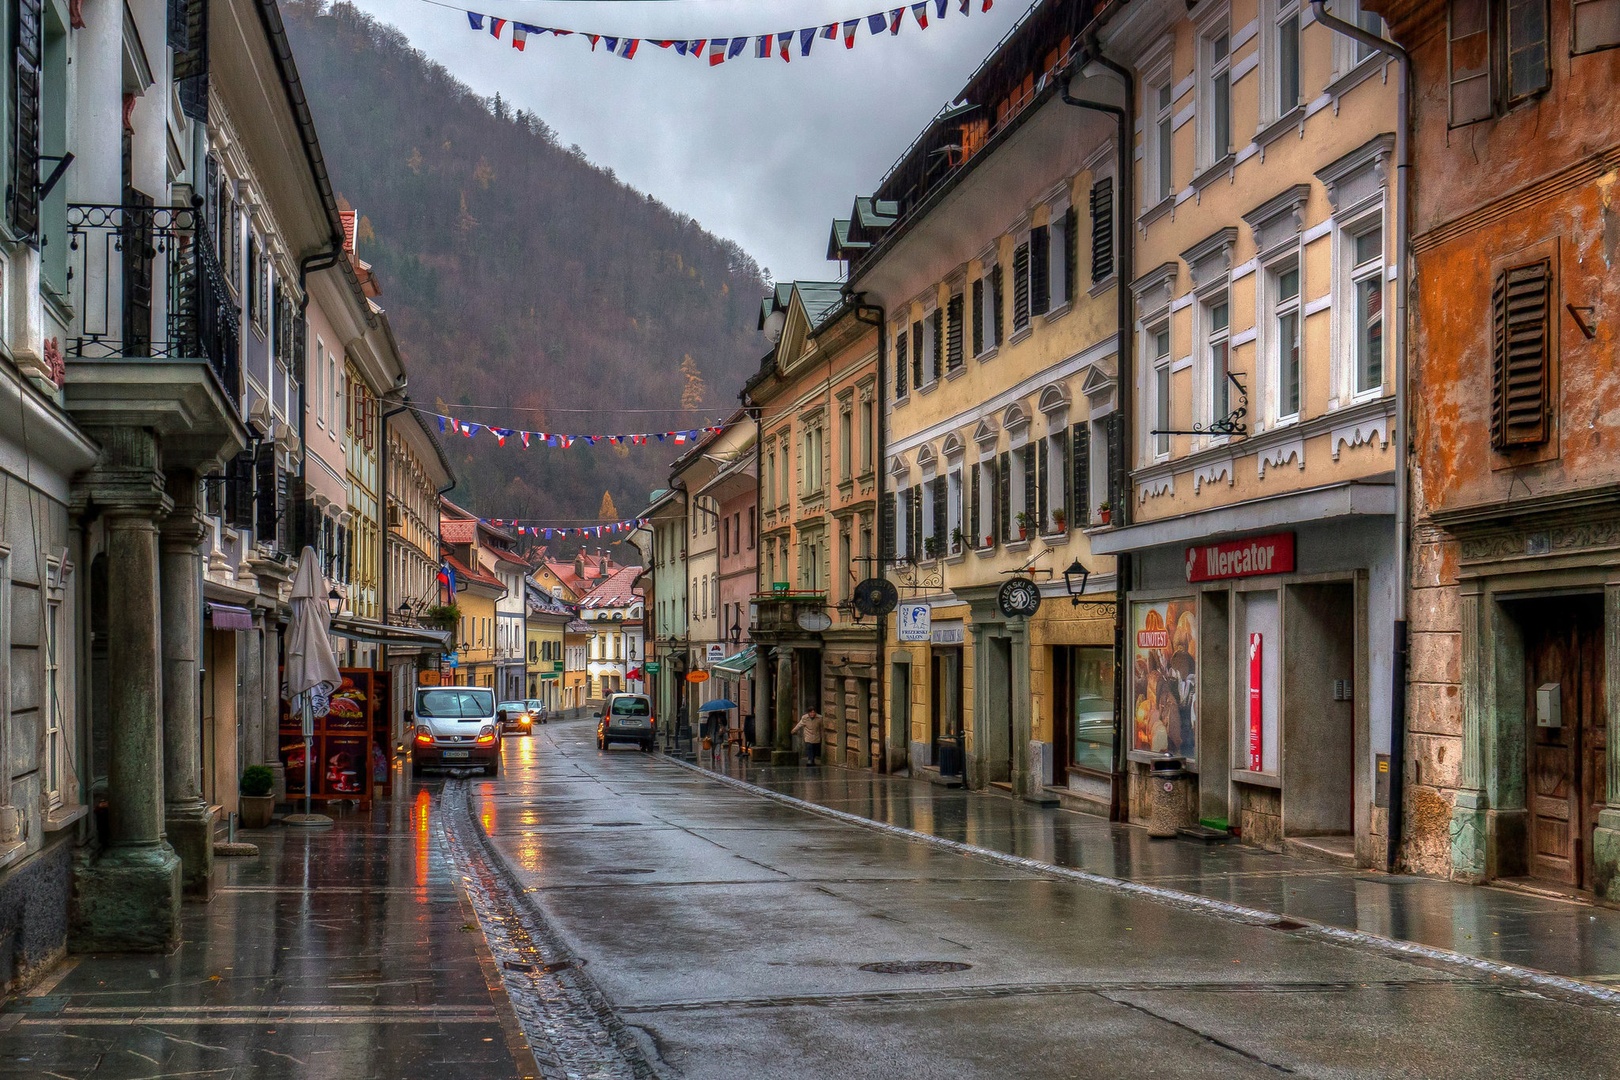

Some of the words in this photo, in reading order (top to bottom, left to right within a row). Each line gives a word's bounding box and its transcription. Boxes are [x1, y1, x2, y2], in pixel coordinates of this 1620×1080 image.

[1206, 543, 1275, 576] Mercator
[1026, 584, 1038, 611] SALON
[1138, 631, 1166, 647] MLINOTEST
